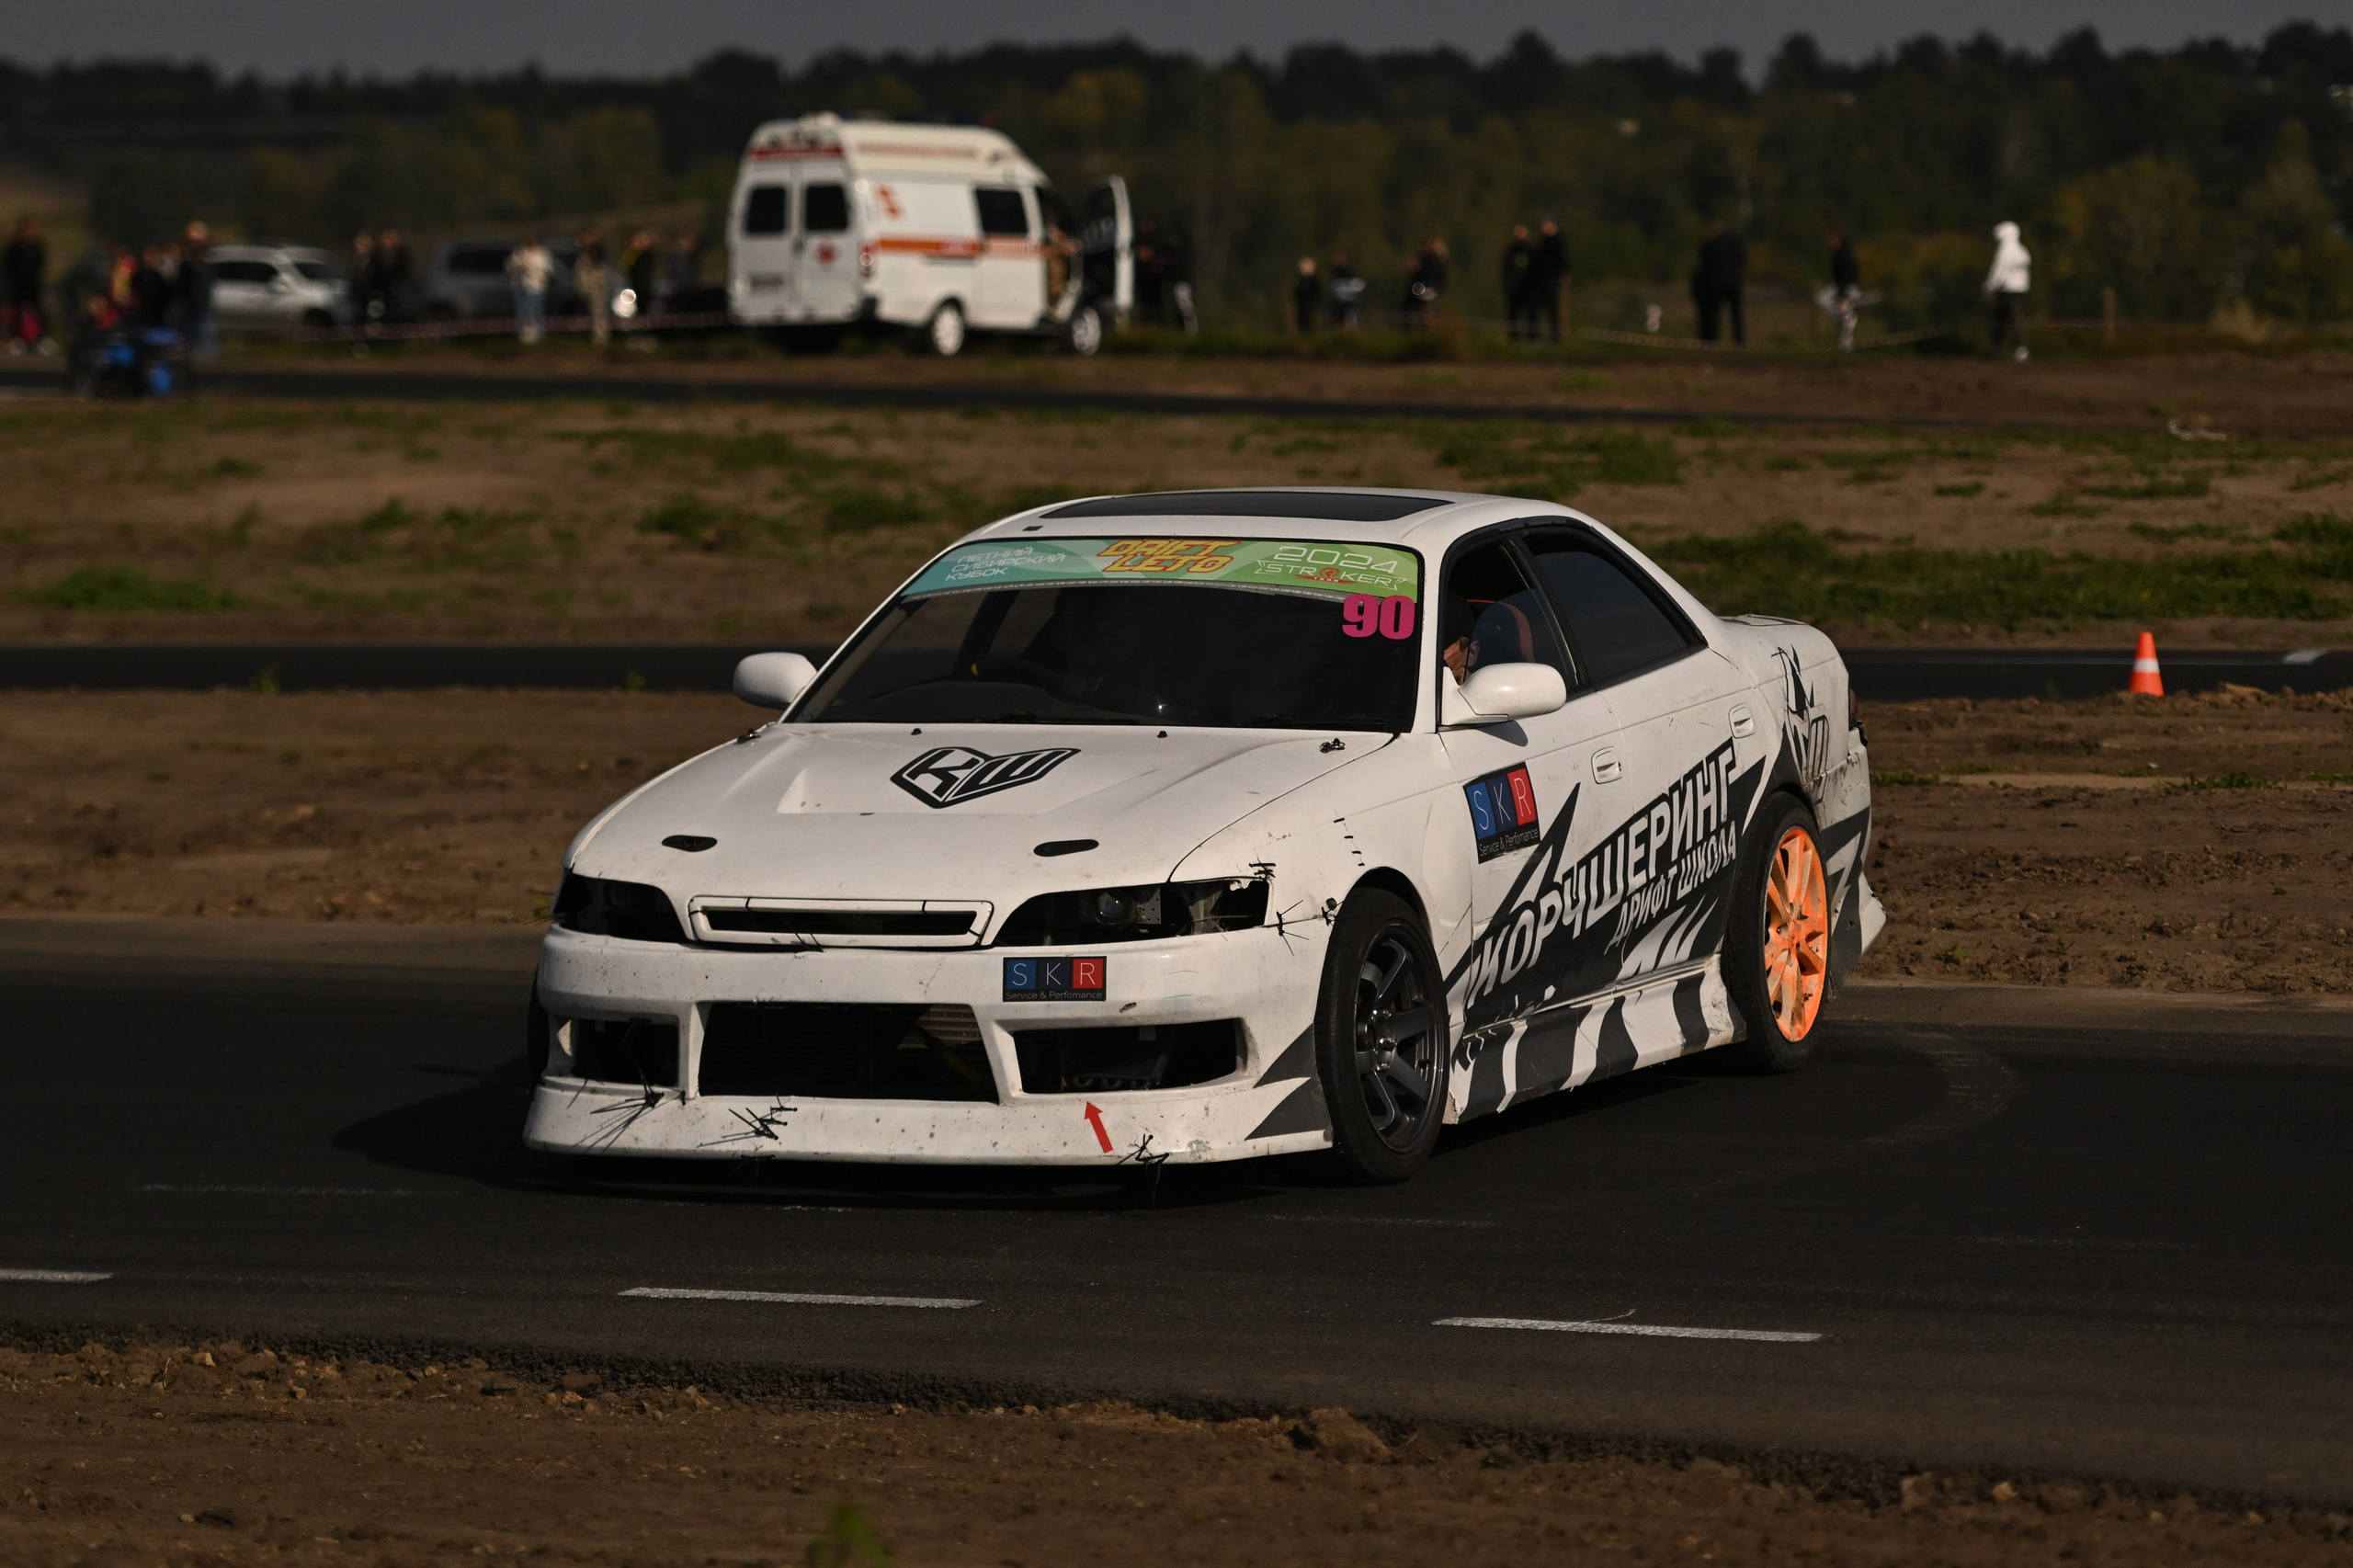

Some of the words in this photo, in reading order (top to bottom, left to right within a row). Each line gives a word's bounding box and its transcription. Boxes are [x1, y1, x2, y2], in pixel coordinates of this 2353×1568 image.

[957, 546, 1034, 564] ЛЕТНИЙ
[1097, 540, 1242, 557] DRIFT
[951, 553, 1066, 573] СИБИРСКИЙ
[1101, 554, 1234, 574] LETO
[1273, 546, 1398, 574] 2024
[945, 567, 1009, 581] КУБОК
[1342, 593, 1415, 641] 90
[1473, 778, 1532, 830] SKR
[1478, 841, 1500, 857] Service
[1500, 836, 1506, 849] &
[1467, 746, 1733, 1010] КОРЧШЕРИНГ
[1603, 864, 1678, 956] ДРИФТ
[1676, 820, 1737, 902] ШКОЛА
[1012, 962, 1096, 986] SKR
[1006, 992, 1038, 1000] Service
[1040, 991, 1047, 999] &
[1049, 990, 1103, 999] Perfomance
